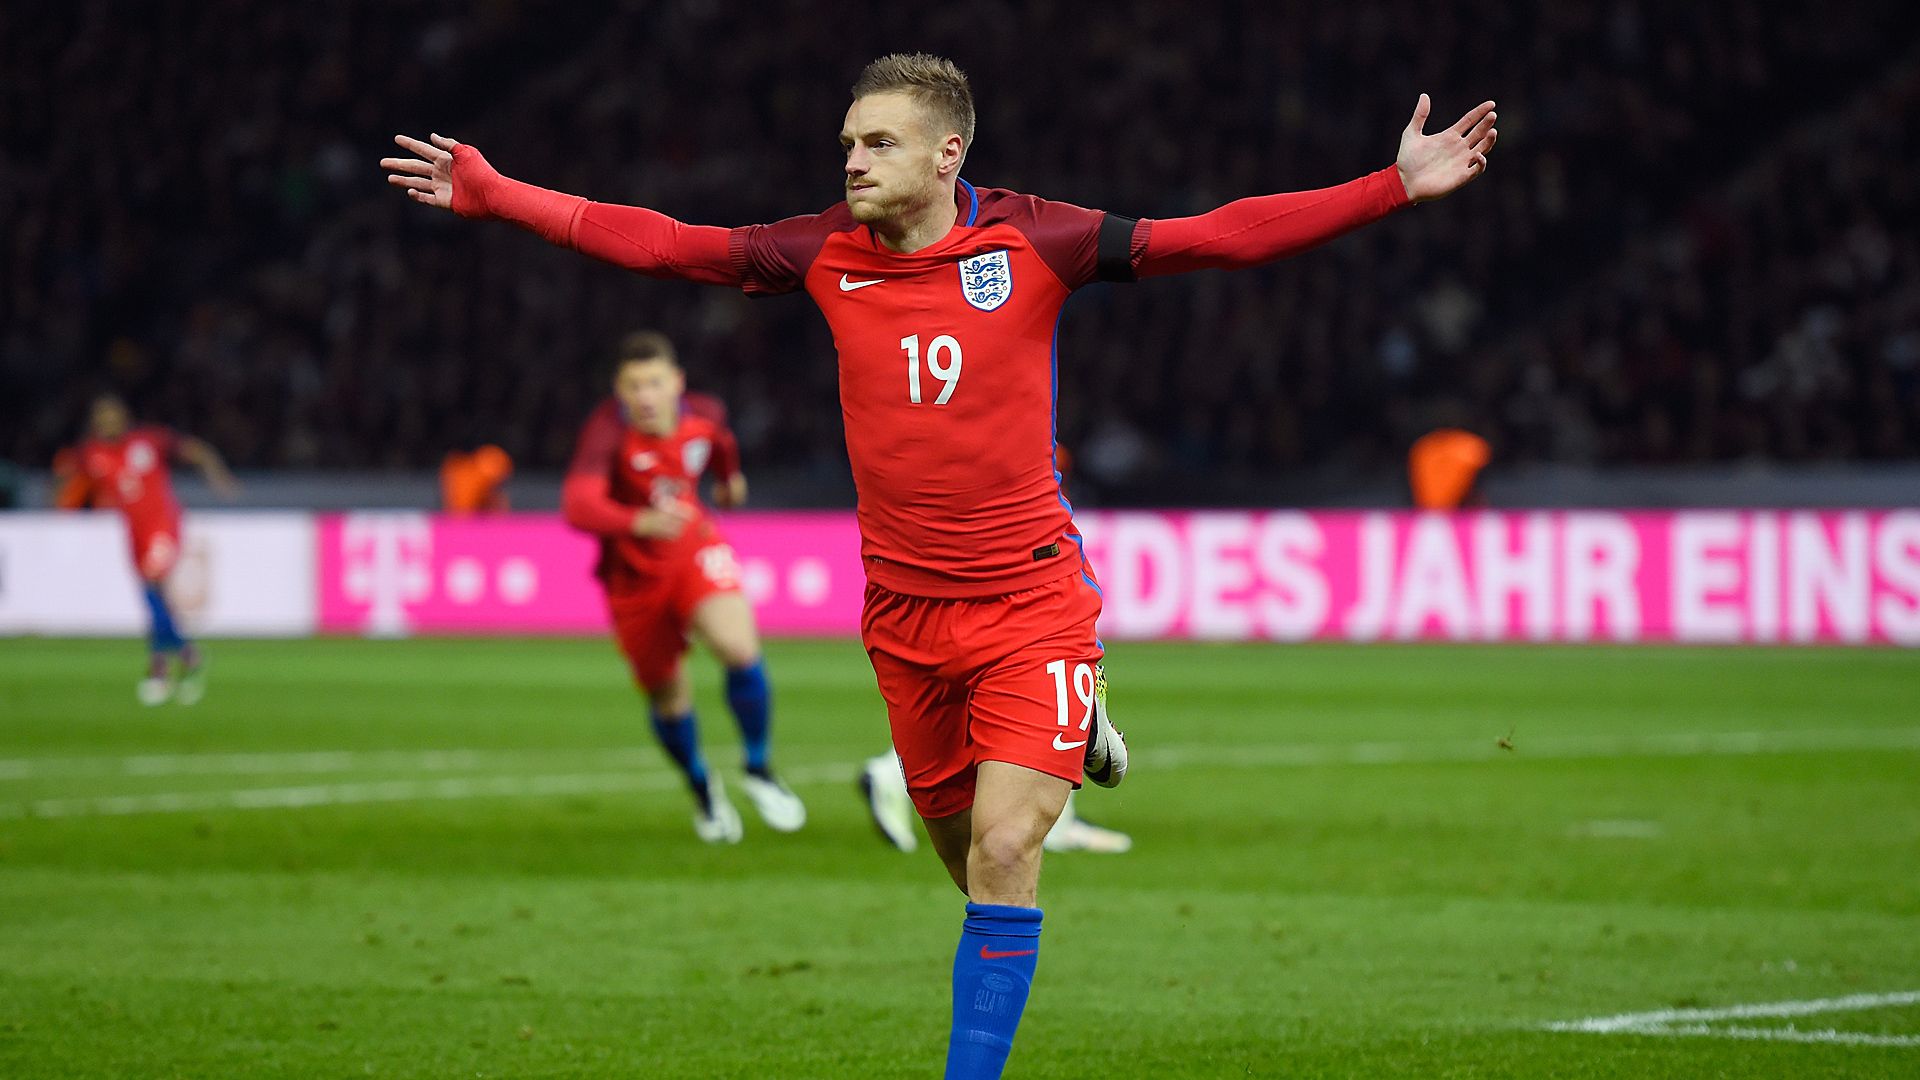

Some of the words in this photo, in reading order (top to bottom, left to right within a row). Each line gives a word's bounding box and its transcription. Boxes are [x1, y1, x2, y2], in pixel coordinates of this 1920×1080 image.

[900, 333, 963, 405] 19
[1348, 511, 1641, 643] JAHR
[1671, 511, 1920, 645] EINS
[1046, 659, 1094, 732] 19
